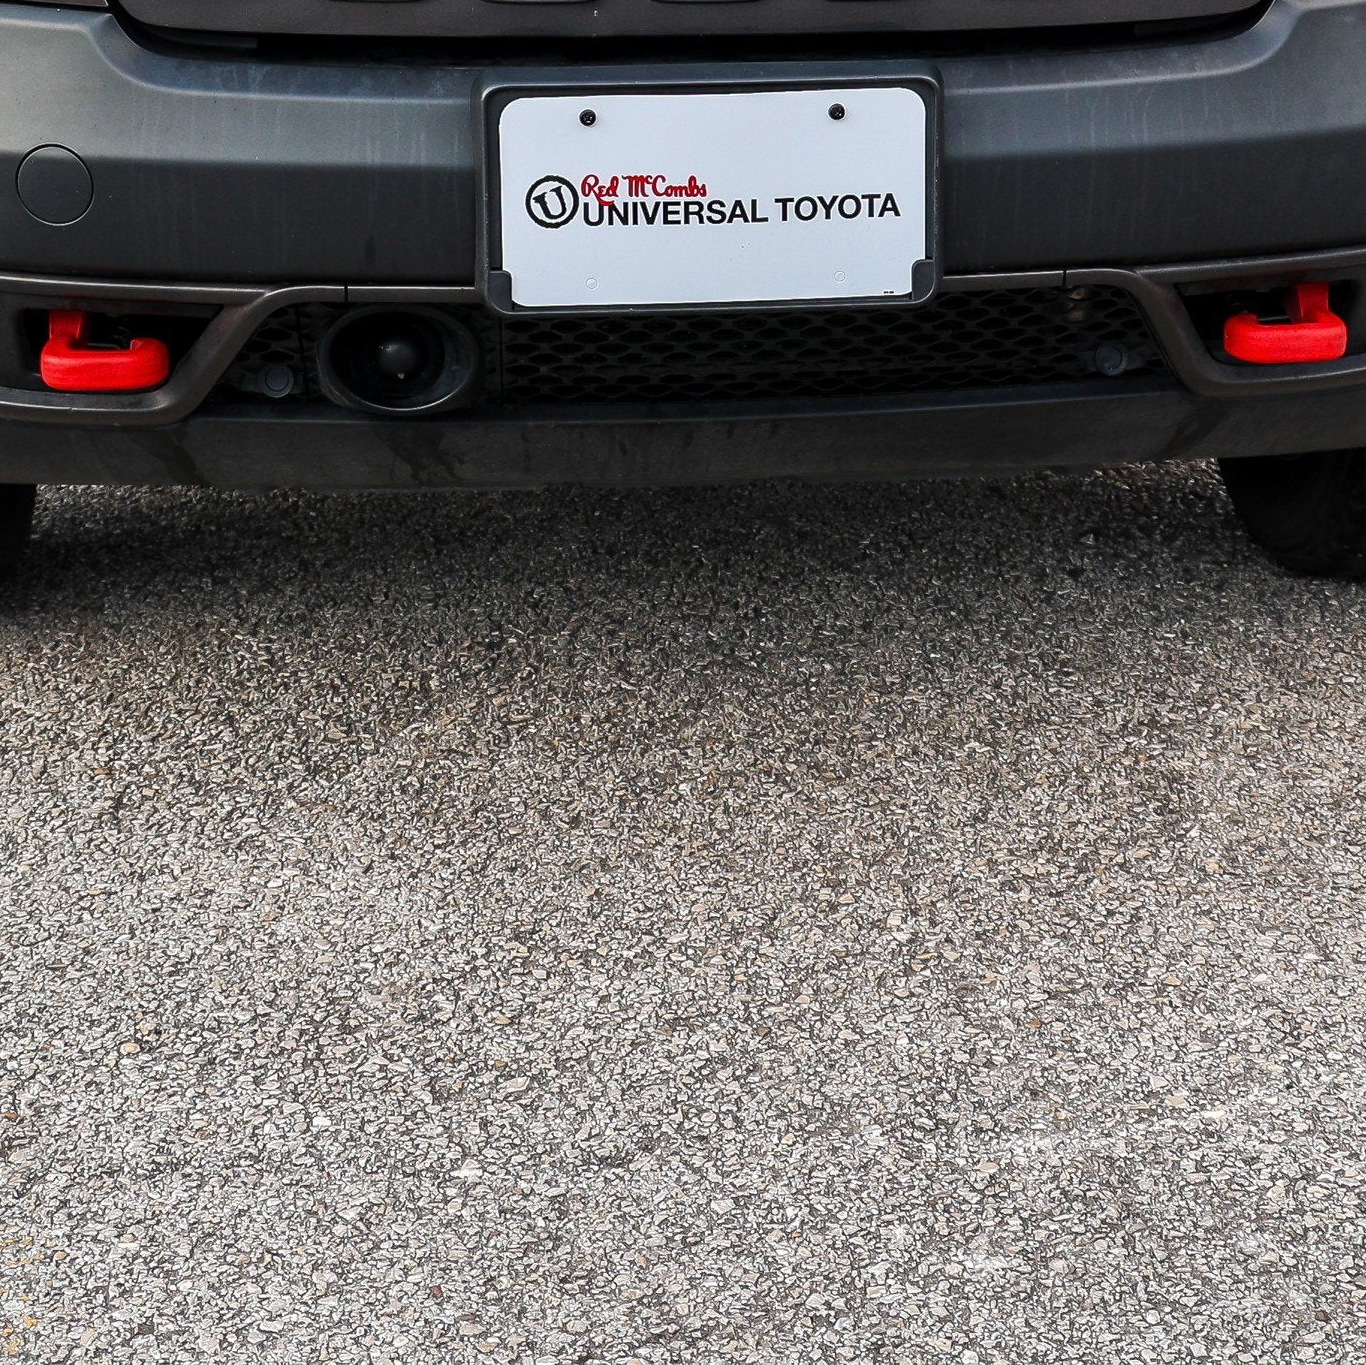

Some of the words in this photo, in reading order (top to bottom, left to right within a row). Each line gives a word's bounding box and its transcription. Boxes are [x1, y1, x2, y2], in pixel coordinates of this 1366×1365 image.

[581, 174, 619, 207] Red
[622, 174, 707, 198] McCombs
[583, 197, 769, 226] UNIVERSAL
[774, 192, 901, 222] TOYOTA
